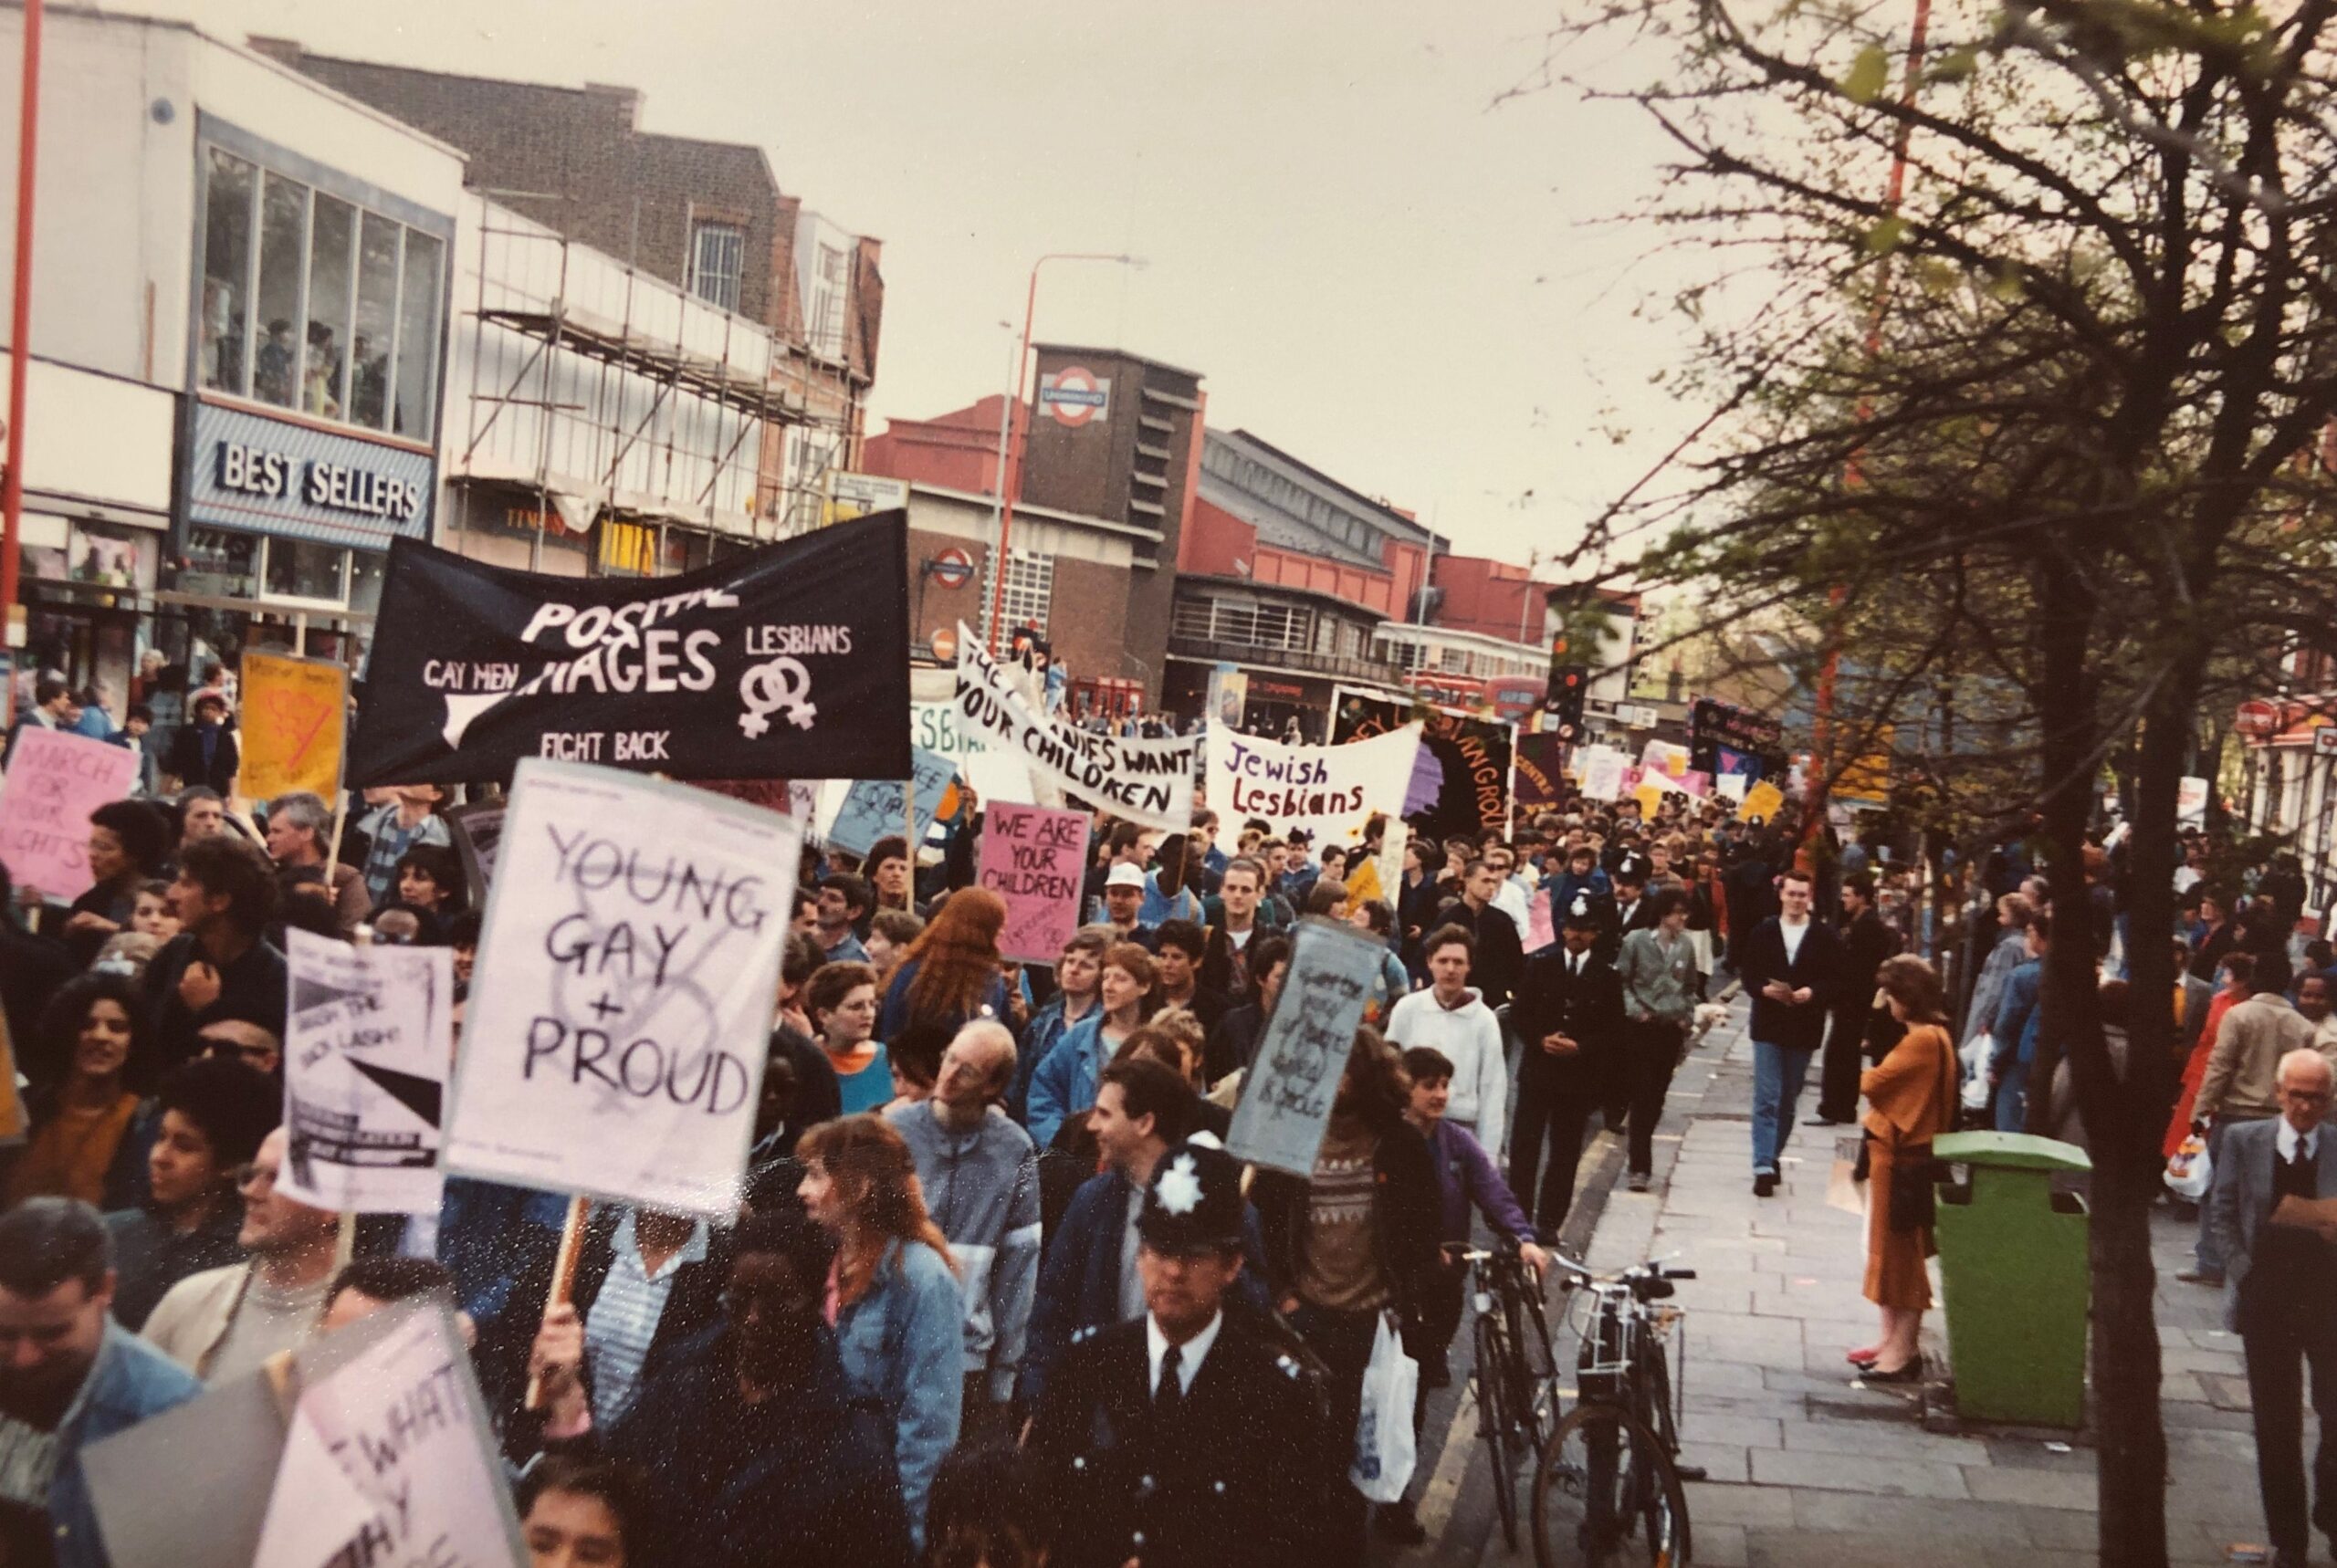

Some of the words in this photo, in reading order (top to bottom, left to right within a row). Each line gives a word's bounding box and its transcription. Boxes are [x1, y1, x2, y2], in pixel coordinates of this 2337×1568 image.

[221, 443, 302, 497] BEST
[309, 461, 420, 520] SELLERS
[745, 624, 853, 655] LESBIANS
[424, 659, 466, 690] GAY
[473, 662, 519, 691] MEN
[955, 675, 1014, 742] YOUR
[22, 742, 116, 785] MARCH
[540, 731, 605, 761] FIGHT
[613, 730, 671, 762] BACK
[1122, 748, 1192, 776] WANT
[1224, 740, 1328, 786] Jewish
[26, 772, 69, 805] FOR
[1232, 776, 1364, 818] Lesbians
[993, 810, 1033, 839] WE
[1035, 816, 1084, 847] ARE
[1011, 843, 1057, 872] YOUR
[546, 821, 769, 935] YOUNG
[981, 868, 1078, 901] CHILDREN
[545, 913, 689, 987] GAY
[590, 991, 624, 1021] +
[522, 1015, 749, 1114] PROUD
